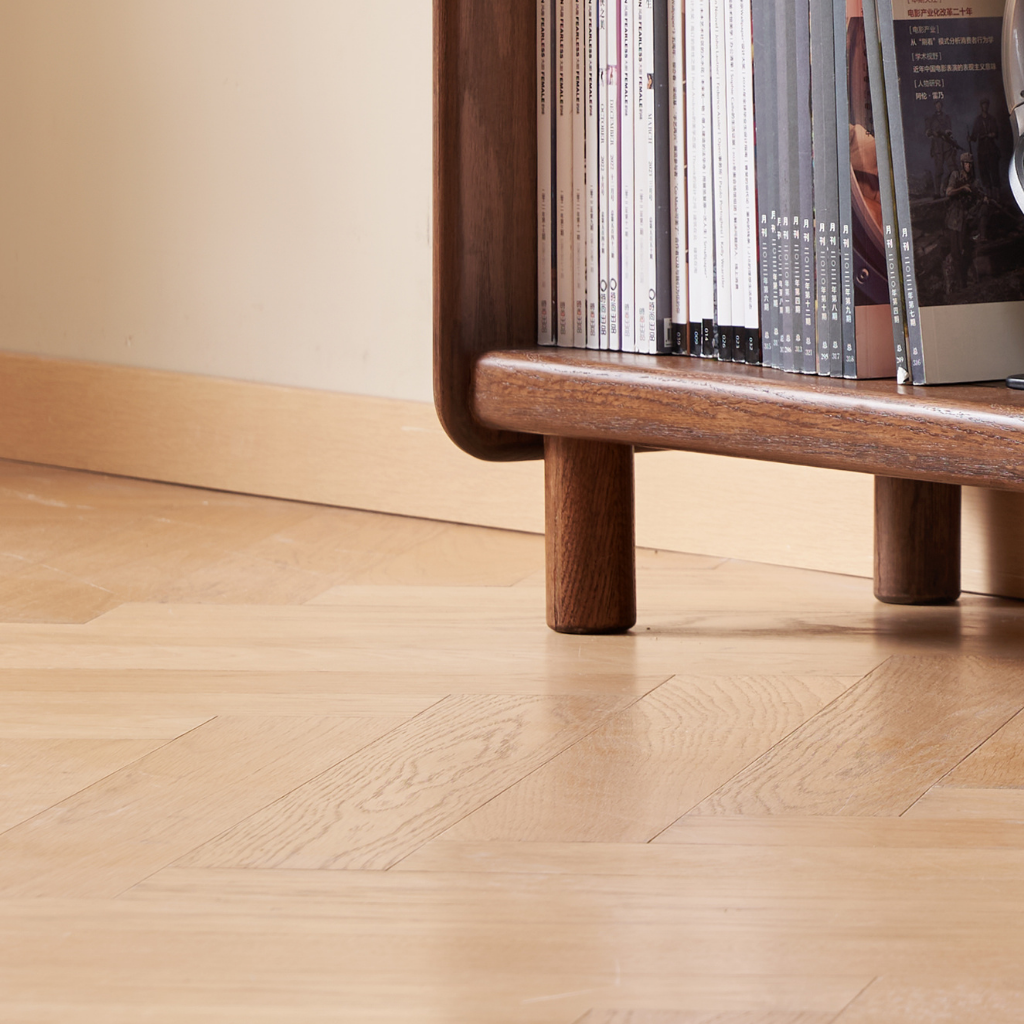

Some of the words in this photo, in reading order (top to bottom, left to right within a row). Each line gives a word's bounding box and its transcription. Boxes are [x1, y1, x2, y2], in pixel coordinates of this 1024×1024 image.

[908, 8, 972, 17] 电影产业化改革二十年
[761, 214, 767, 237] 月刊
[783, 216, 789, 239] 月刊
[793, 216, 799, 239] 月刊
[803, 219, 809, 242] 月刊
[819, 223, 826, 246] 月刊
[829, 222, 836, 246] 月刊
[843, 225, 850, 248] 月刊
[886, 225, 893, 248] 月刊
[902, 227, 910, 251] 月刊
